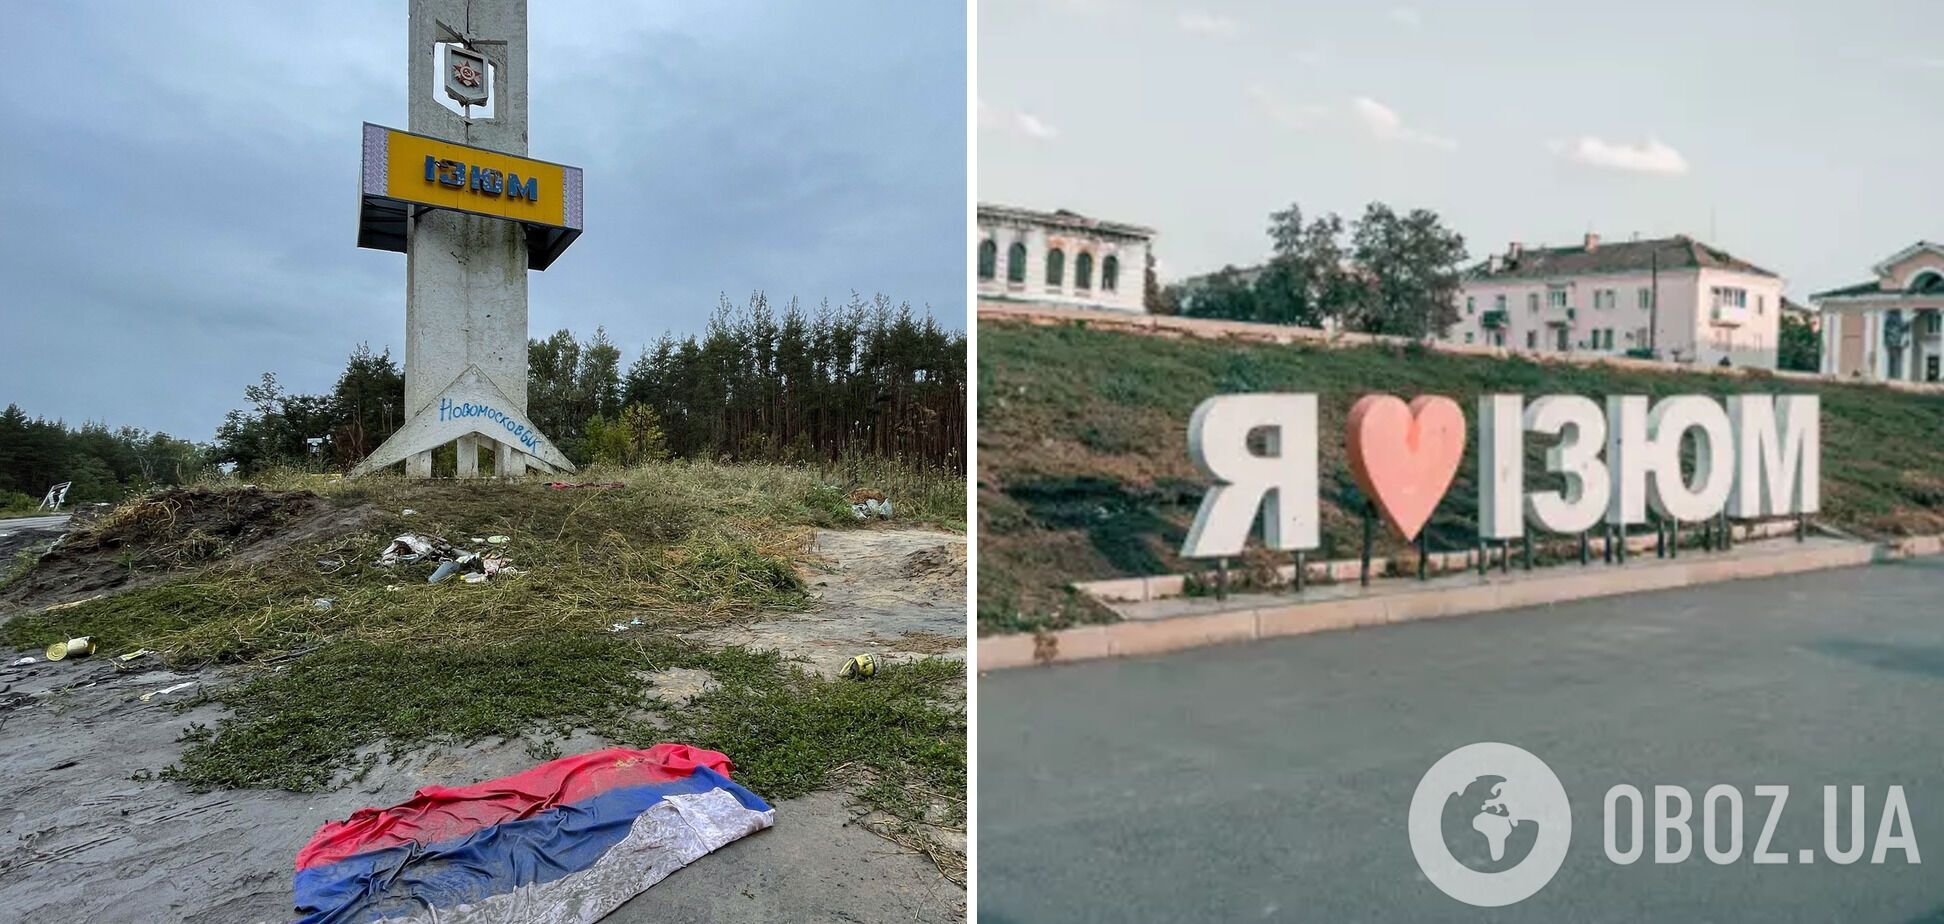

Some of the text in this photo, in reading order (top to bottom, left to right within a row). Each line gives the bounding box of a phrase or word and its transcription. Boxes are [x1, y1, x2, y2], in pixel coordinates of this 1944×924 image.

[424, 155, 538, 202] ІЗЮМ
[1181, 393, 1820, 557] Я ІЗЮМ
